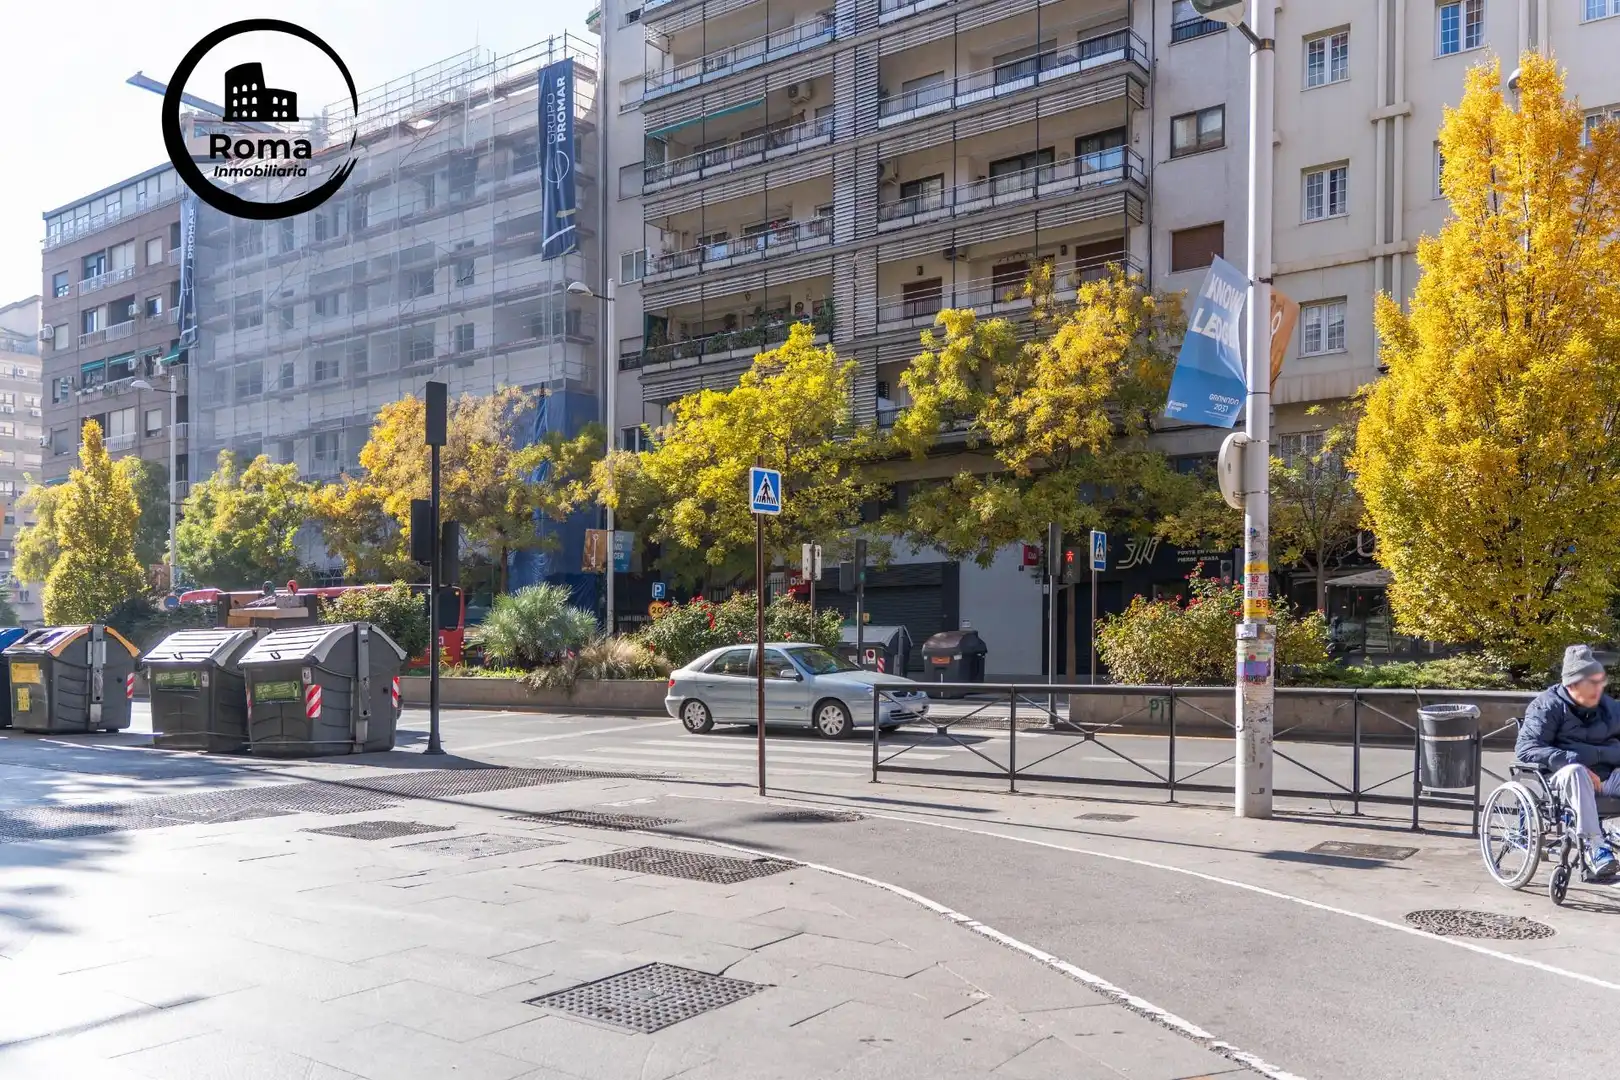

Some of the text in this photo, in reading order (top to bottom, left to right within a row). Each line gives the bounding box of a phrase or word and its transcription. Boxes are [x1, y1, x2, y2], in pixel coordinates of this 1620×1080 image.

[546, 92, 556, 145] GRUPO
[556, 75, 567, 143] PROMAR
[187, 208, 196, 260] PROMAR
[1205, 273, 1246, 313] KNOW
[1213, 403, 1229, 413] 2031
[651, 606, 663, 614] 20
[654, 584, 662, 597] P
